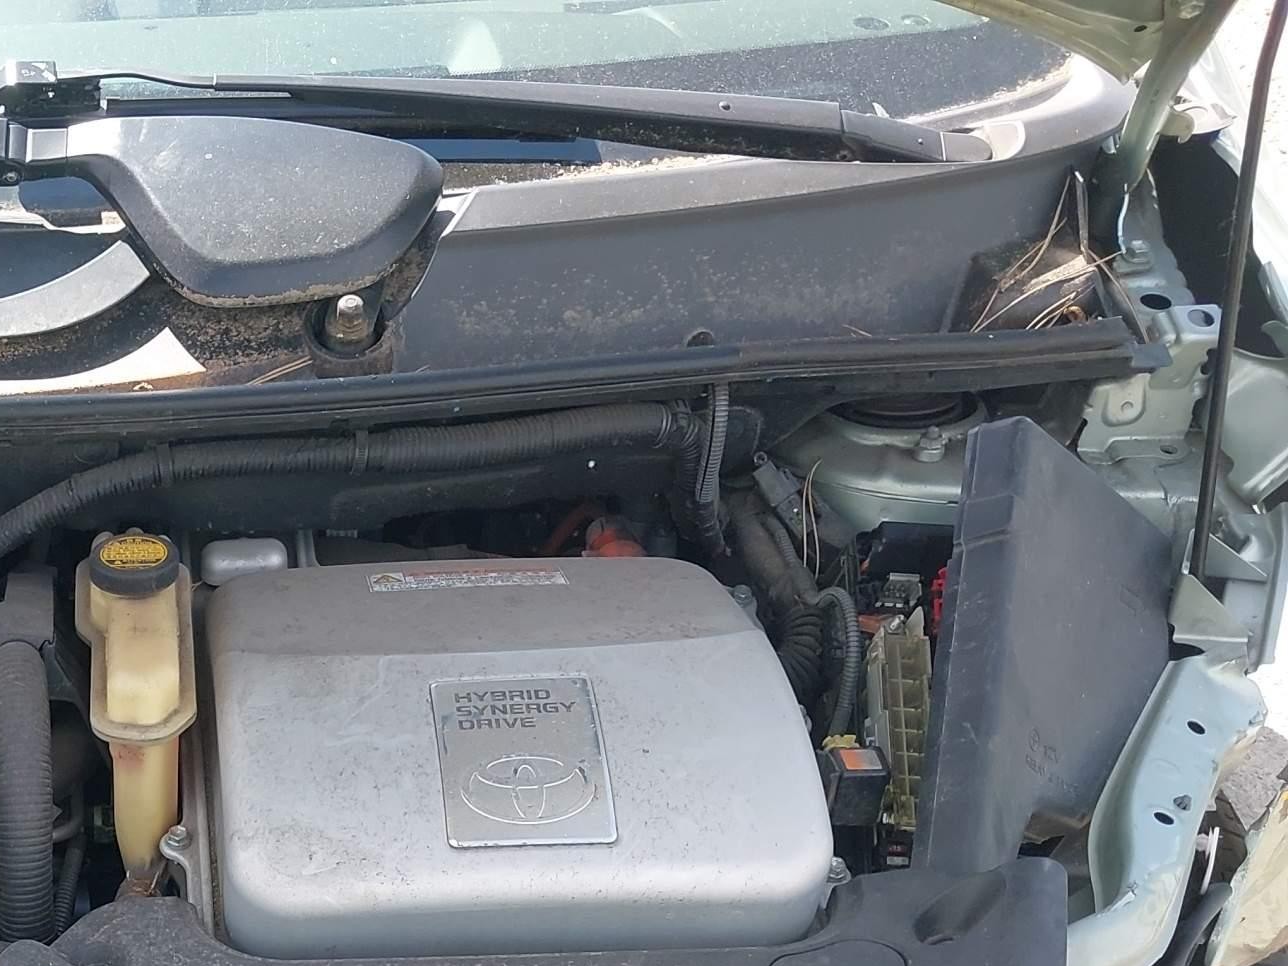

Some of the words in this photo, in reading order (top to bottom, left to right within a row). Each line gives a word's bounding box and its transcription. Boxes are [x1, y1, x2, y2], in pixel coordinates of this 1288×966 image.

[454, 689, 551, 703] HYBRID
[456, 702, 576, 716] SYNERGY
[458, 717, 536, 730] DRIVE
